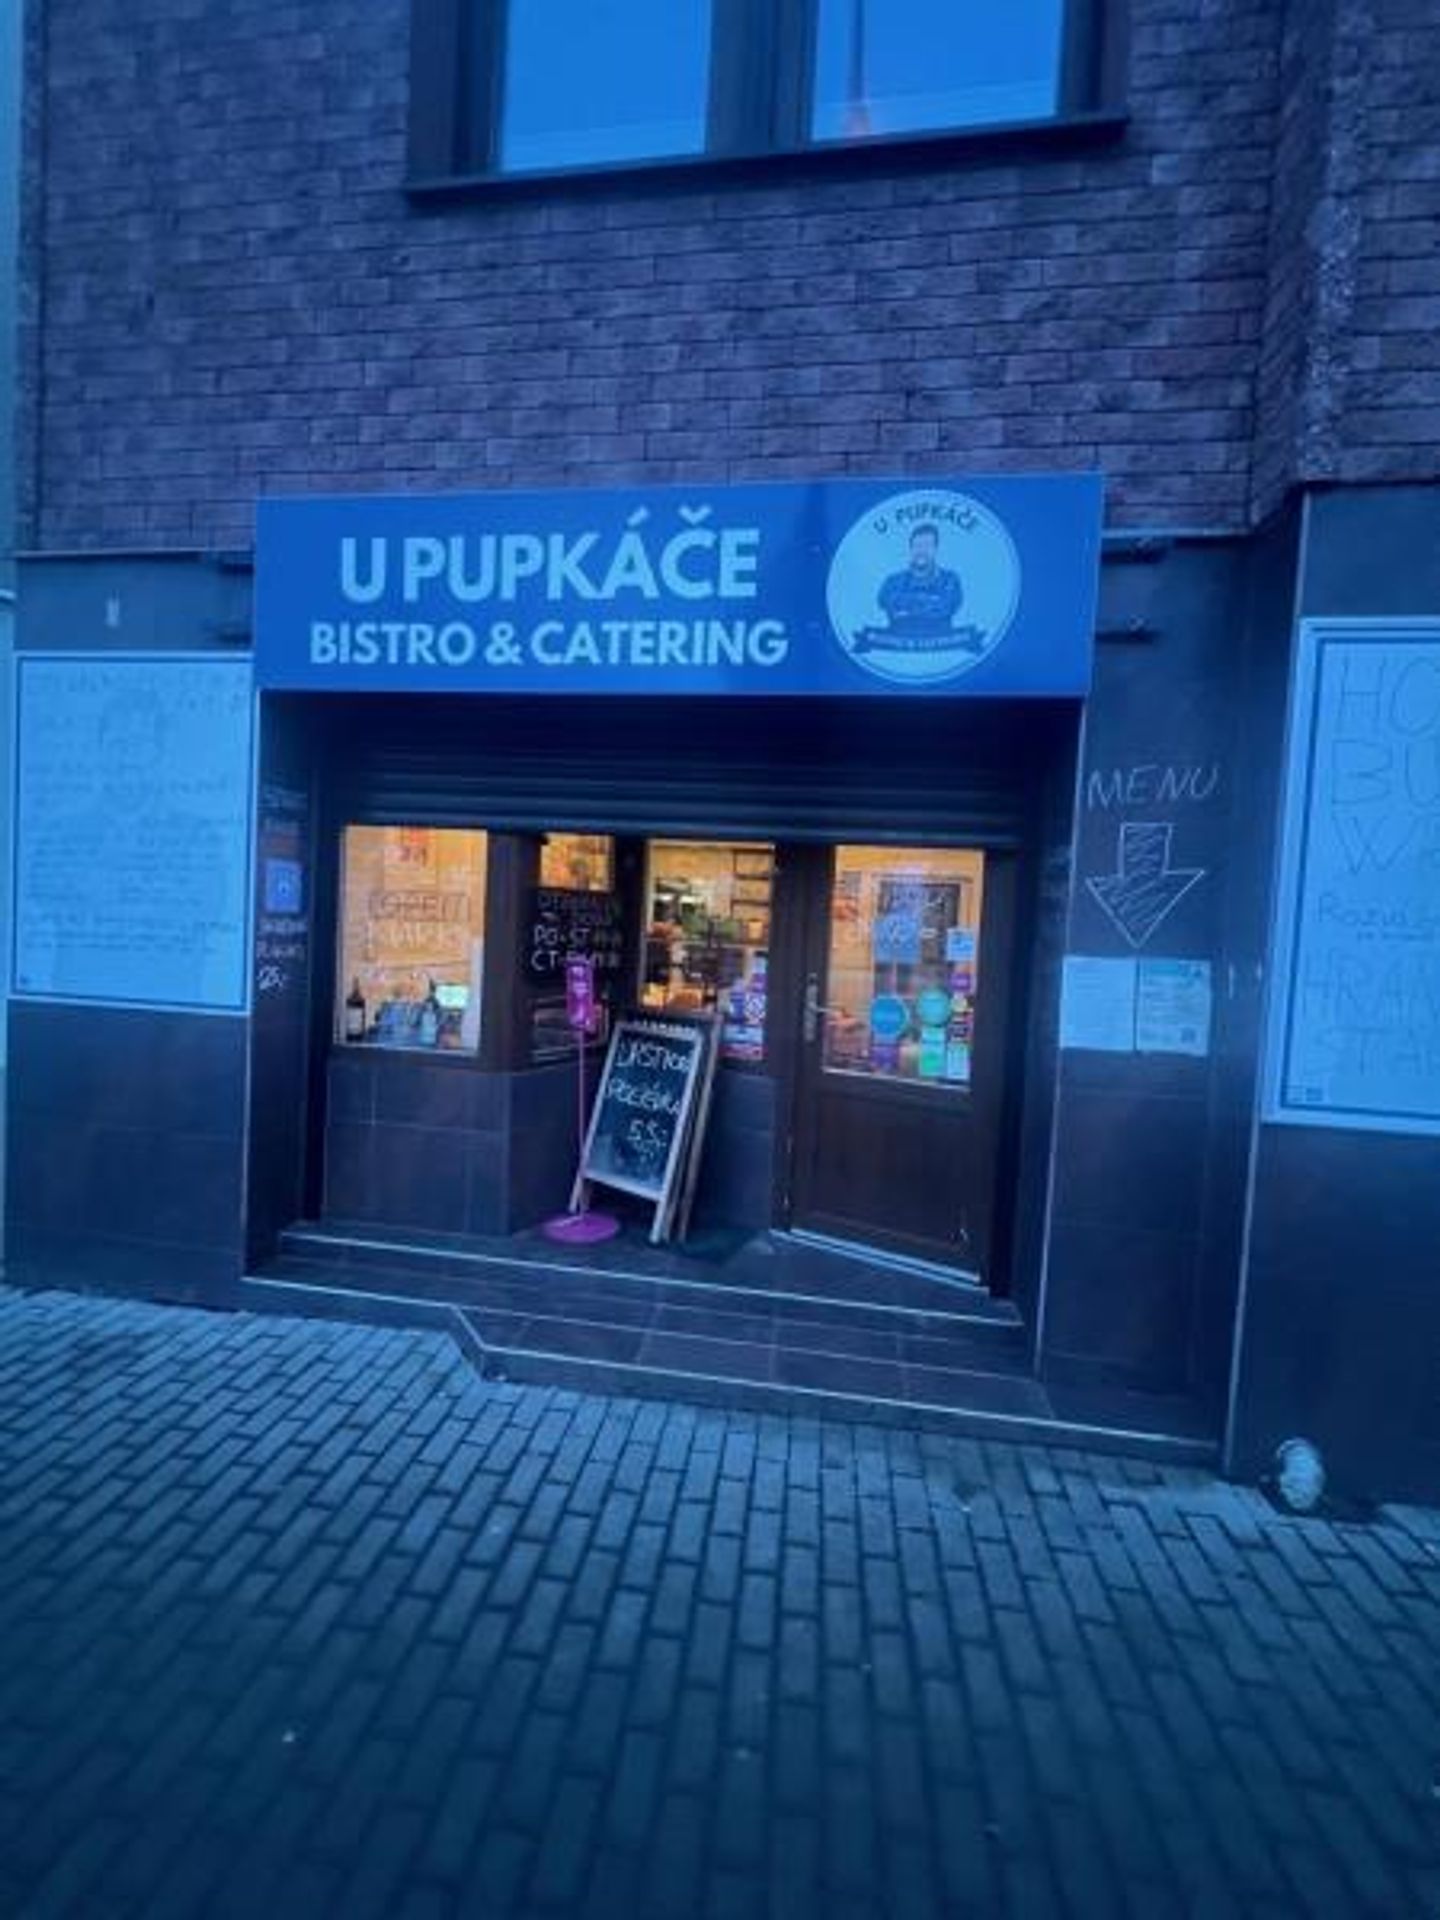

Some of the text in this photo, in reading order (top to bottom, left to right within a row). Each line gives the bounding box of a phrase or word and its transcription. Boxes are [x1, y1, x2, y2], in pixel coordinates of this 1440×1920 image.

[340, 505, 761, 602] U PUPKÁČE
[309, 619, 790, 667] BISTRO & CATERING
[1088, 763, 1219, 811] MENU
